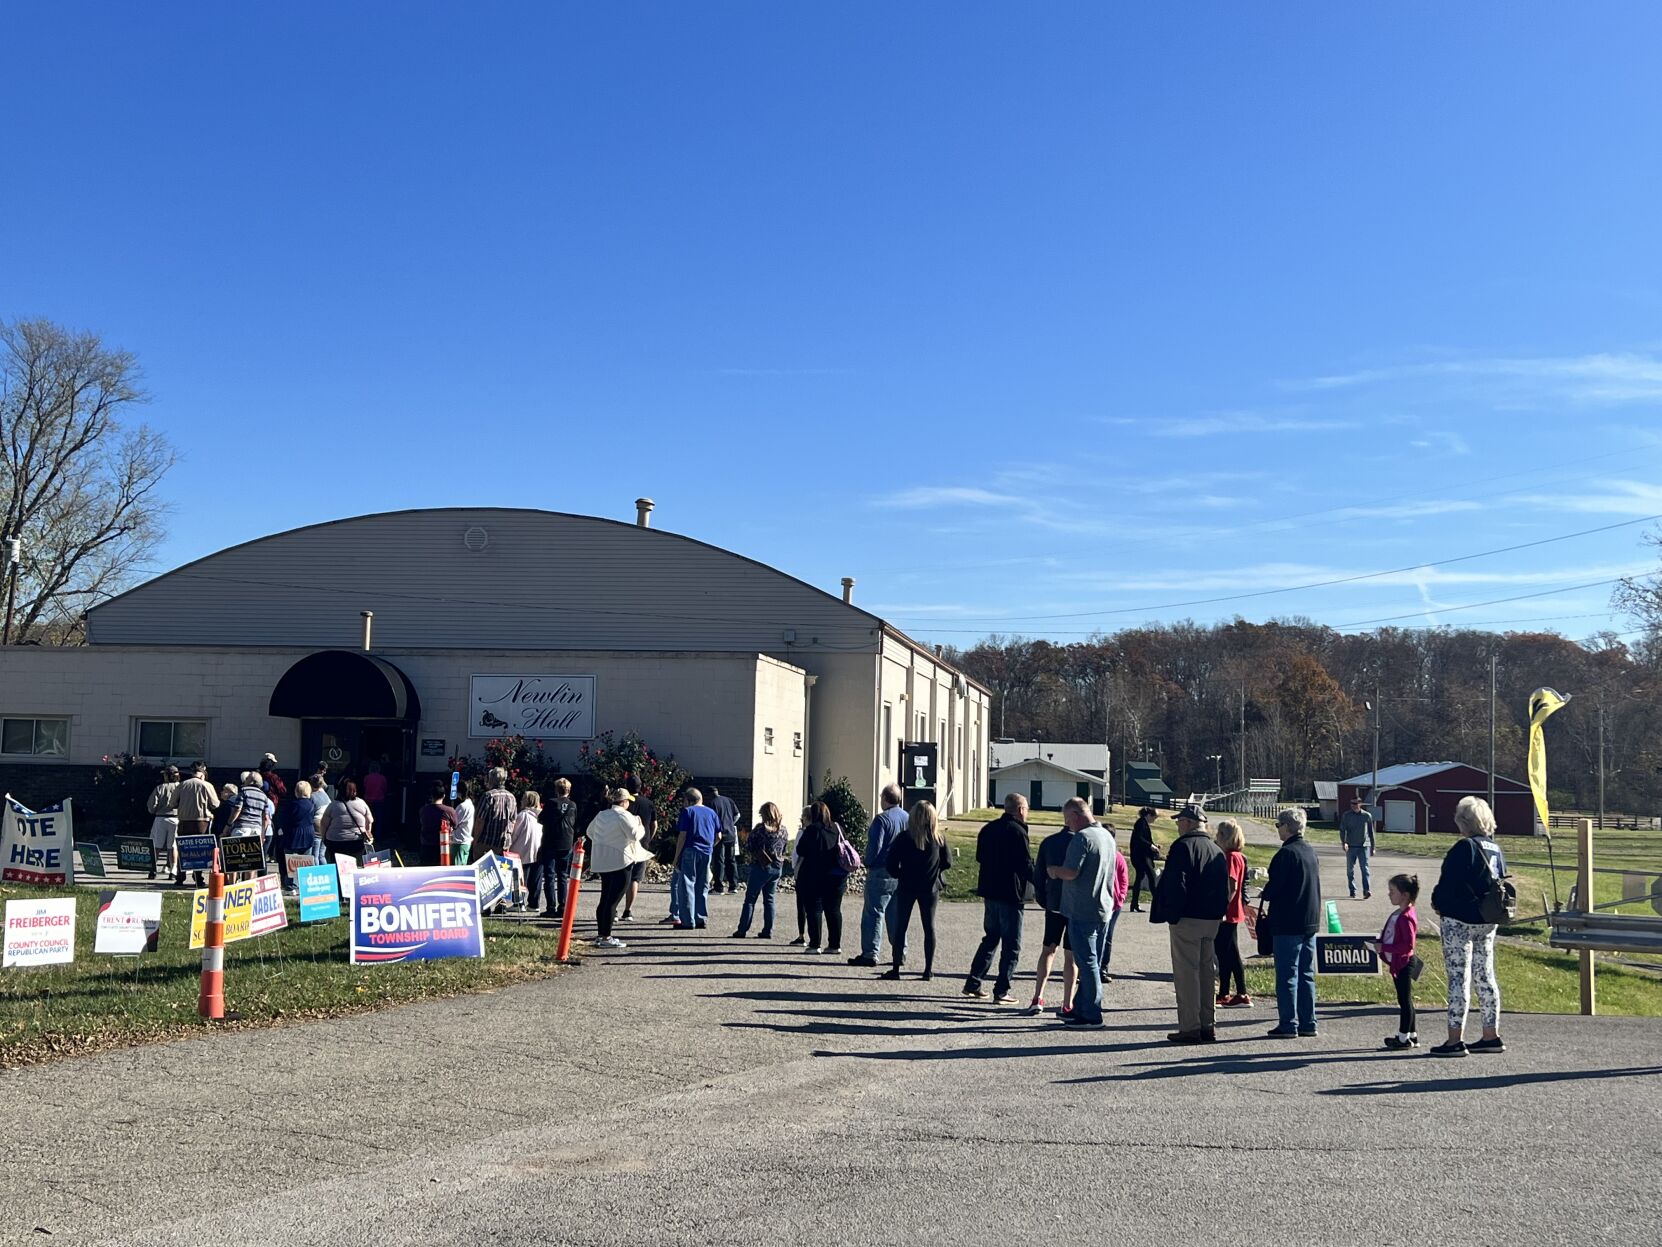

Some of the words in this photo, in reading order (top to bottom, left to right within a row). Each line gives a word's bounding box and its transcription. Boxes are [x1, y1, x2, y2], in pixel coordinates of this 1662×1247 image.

[479, 679, 583, 704] Newlin
[513, 708, 582, 730] Hall
[120, 845, 150, 854] STUMLER
[224, 842, 260, 854] TORAN
[306, 873, 330, 887] dana
[359, 875, 379, 886] Elect
[361, 894, 392, 905] STEVE
[9, 915, 70, 929] FREIBERGER
[361, 902, 473, 933] BONIFER
[226, 921, 249, 935] BOARD
[369, 930, 430, 945] TOWNSHIP
[433, 928, 469, 940] BOARD
[8, 940, 38, 949] COUNTY
[40, 938, 69, 947] COUNCIL
[8, 948, 48, 957] REPUBLICAN
[1325, 950, 1370, 963] RONAU
